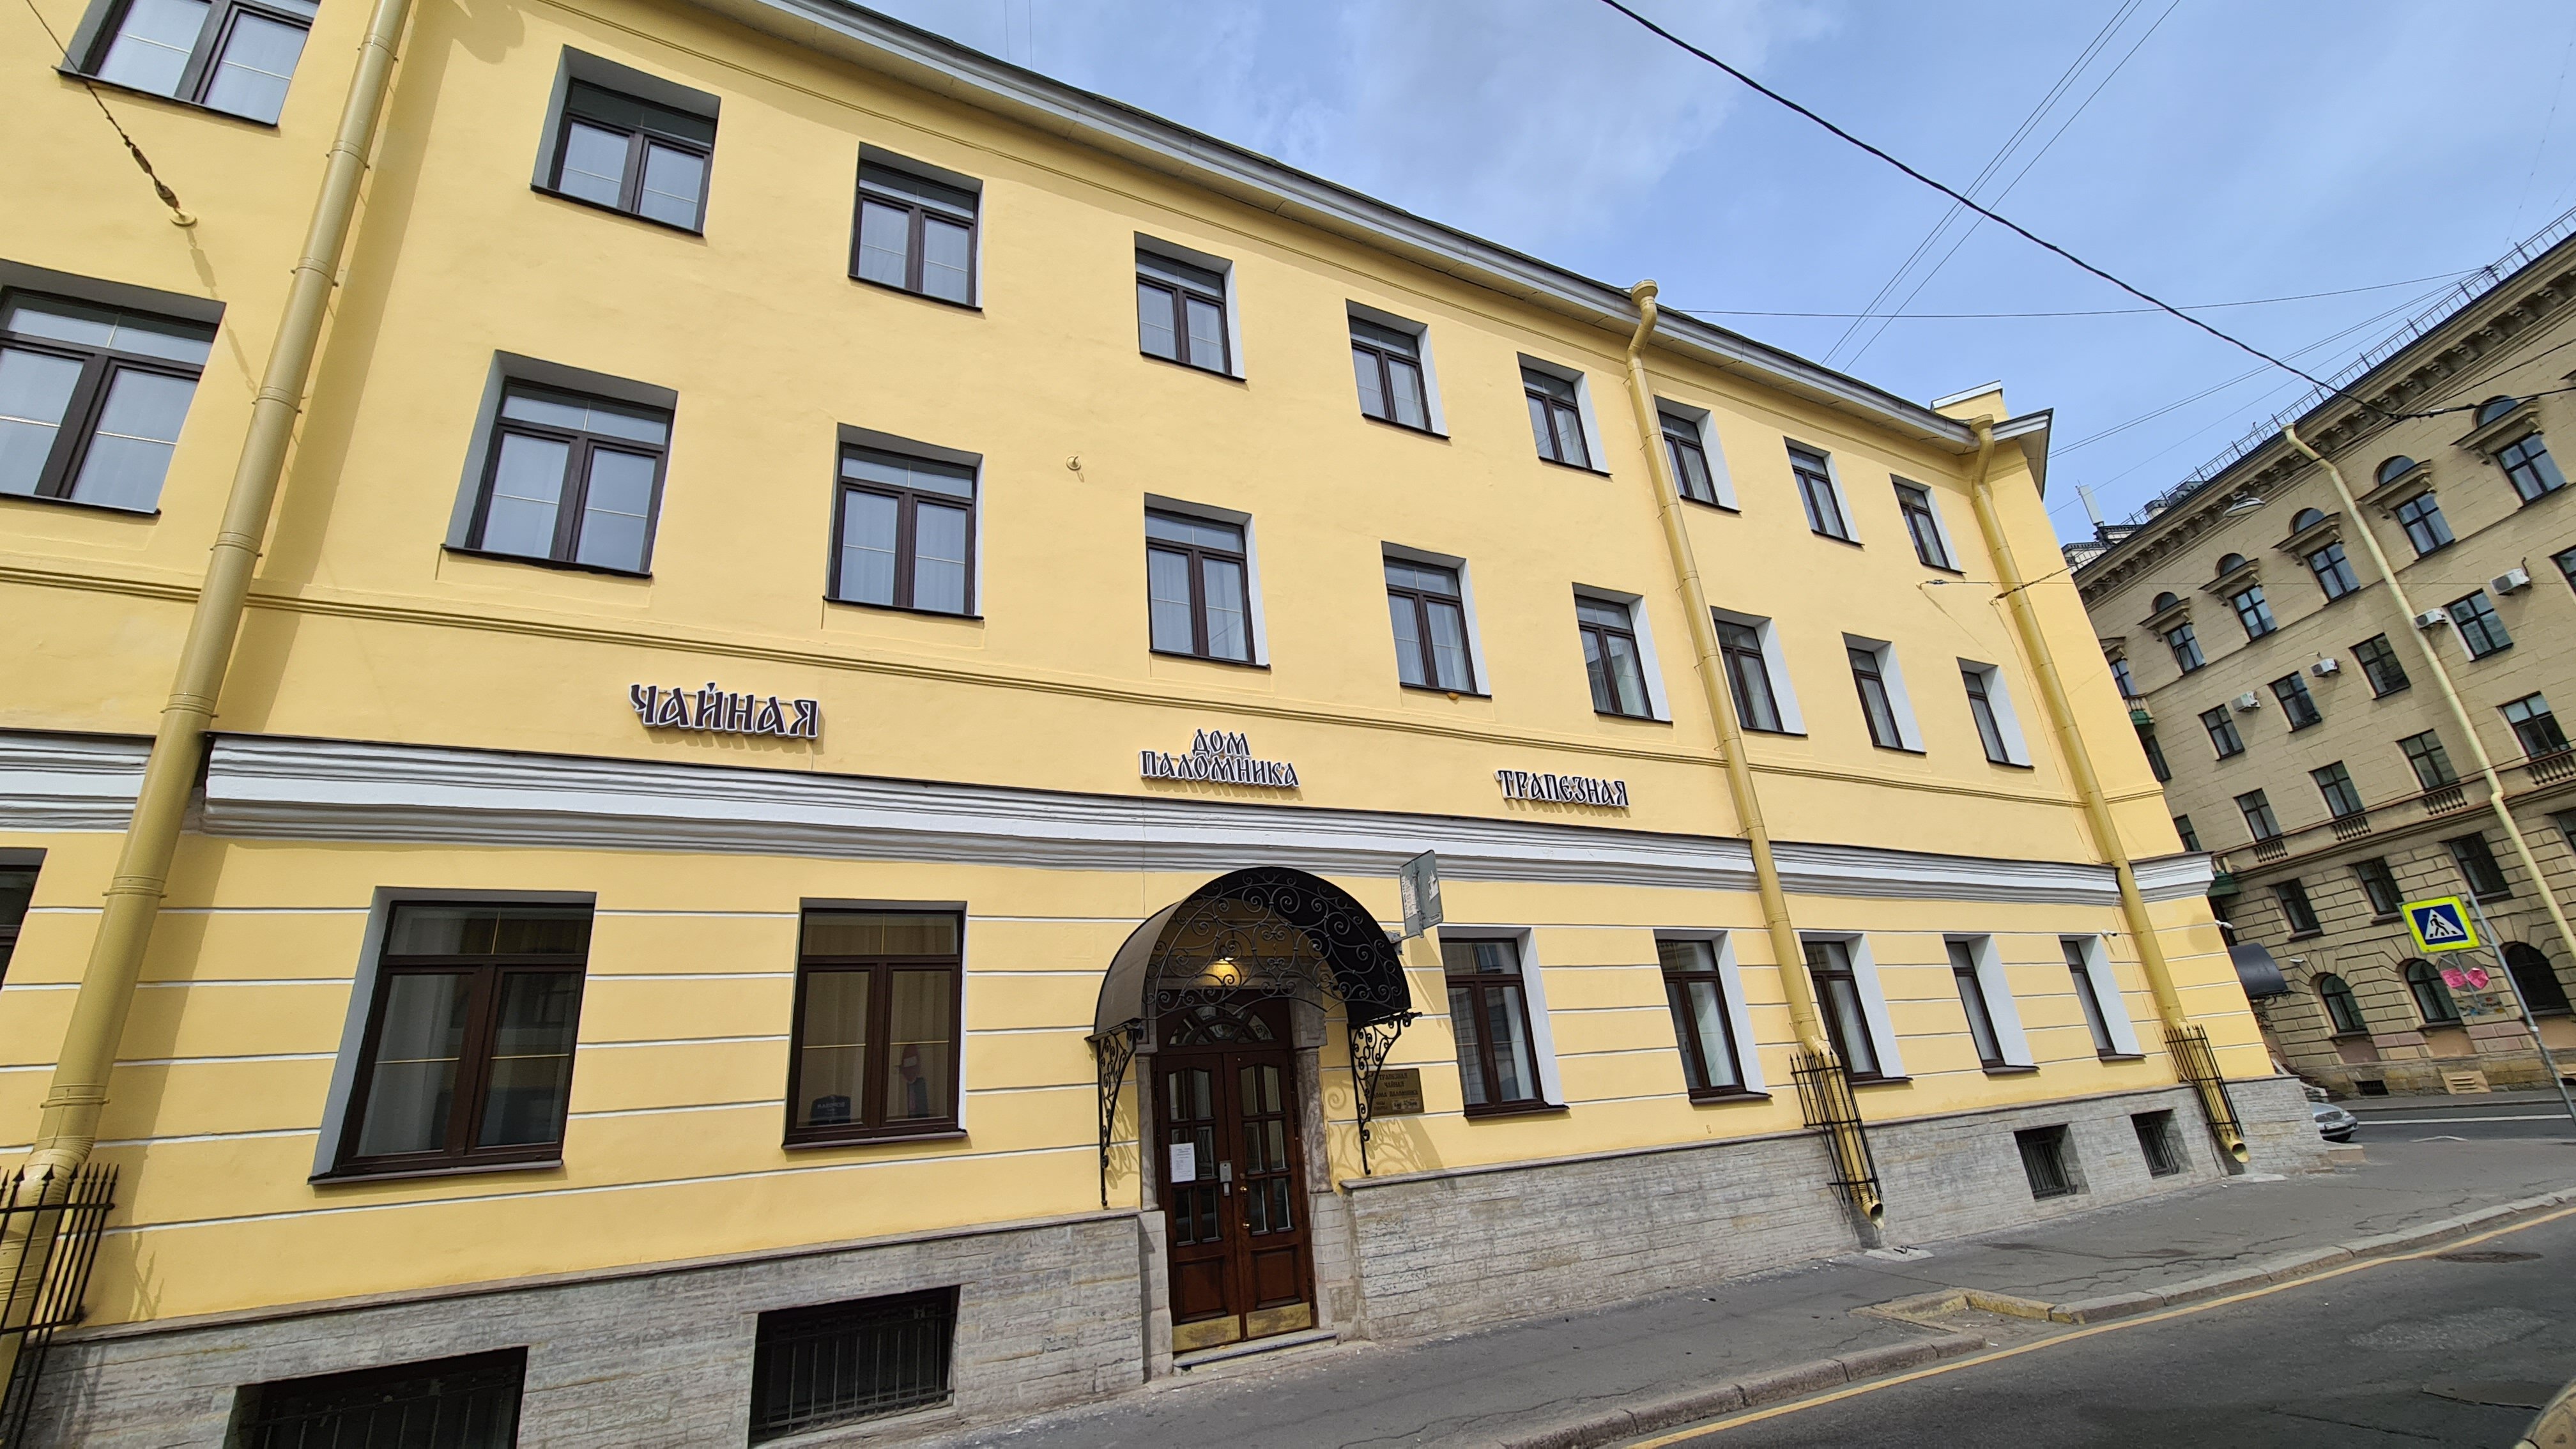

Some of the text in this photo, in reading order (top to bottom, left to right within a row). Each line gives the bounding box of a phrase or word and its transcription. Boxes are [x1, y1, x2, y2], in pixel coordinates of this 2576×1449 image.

[629, 682, 818, 739] ЧАЙНАЯ
[1191, 728, 1252, 757] ДОМ
[1140, 749, 1300, 787] ПАЛОМНИКА
[1497, 769, 1629, 807] ТРАПЕЗНАЯ
